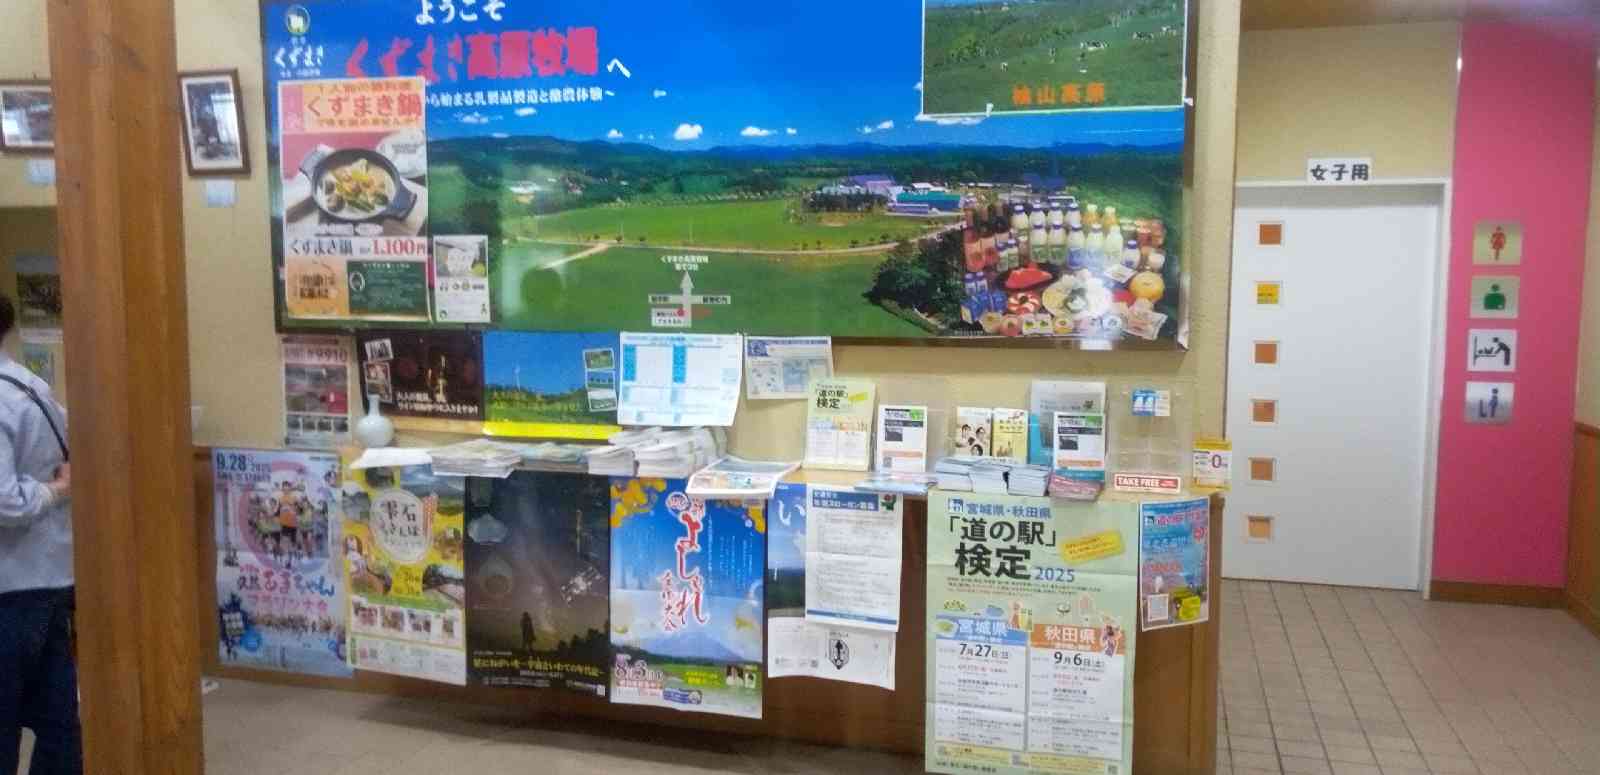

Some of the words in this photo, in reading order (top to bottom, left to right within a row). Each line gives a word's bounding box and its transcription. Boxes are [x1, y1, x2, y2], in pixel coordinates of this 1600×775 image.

[415, 0, 506, 25] ようこそ
[1309, 163, 1370, 181] 女子用
[1117, 476, 1140, 488] TAKE
[1141, 478, 1161, 489] FREE
[967, 501, 1052, 519] 宮城県・秋田県
[948, 516, 1057, 548] 「道の駅」
[955, 543, 1032, 580] 検定
[1034, 567, 1075, 583] 2025
[958, 618, 1007, 638] 宮城県
[1045, 626, 1096, 644] 秋田県
